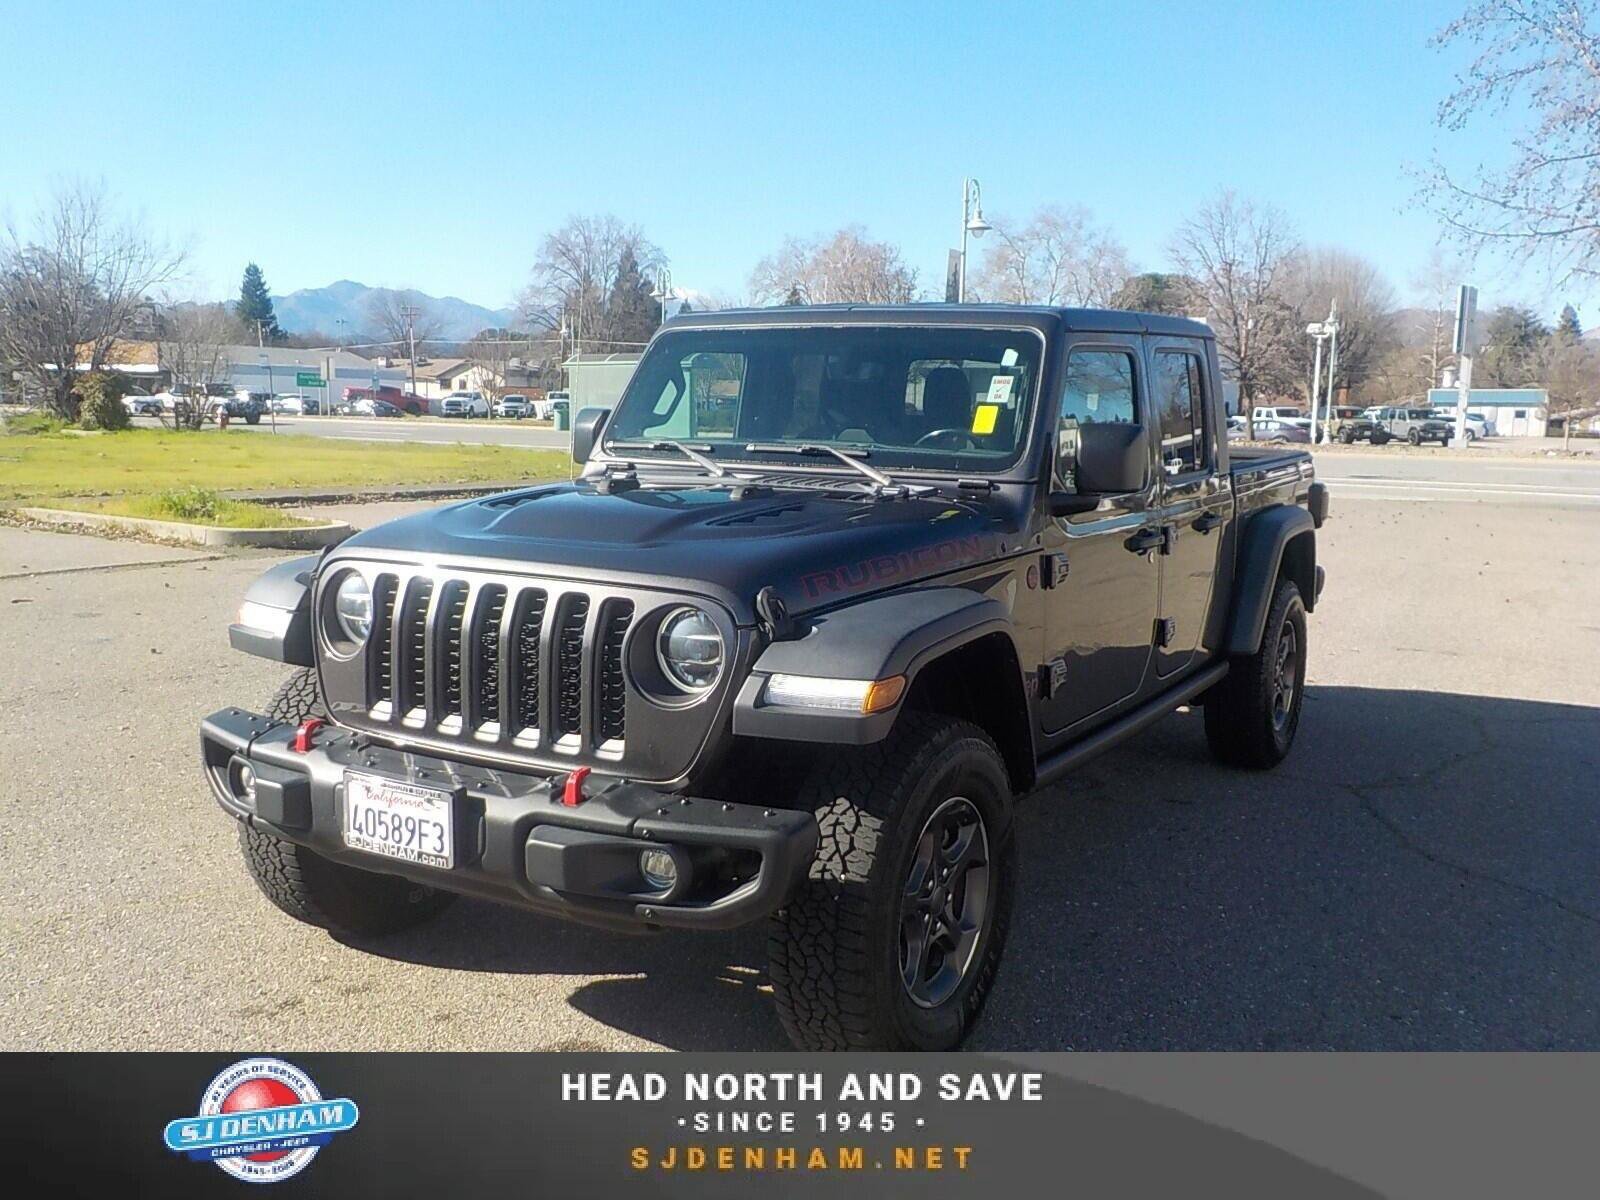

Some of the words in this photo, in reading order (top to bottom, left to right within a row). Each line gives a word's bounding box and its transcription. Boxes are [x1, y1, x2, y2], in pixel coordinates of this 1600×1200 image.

[800, 535, 984, 601] RUBICON
[362, 785, 425, 809] California
[353, 803, 445, 853] 40589F3
